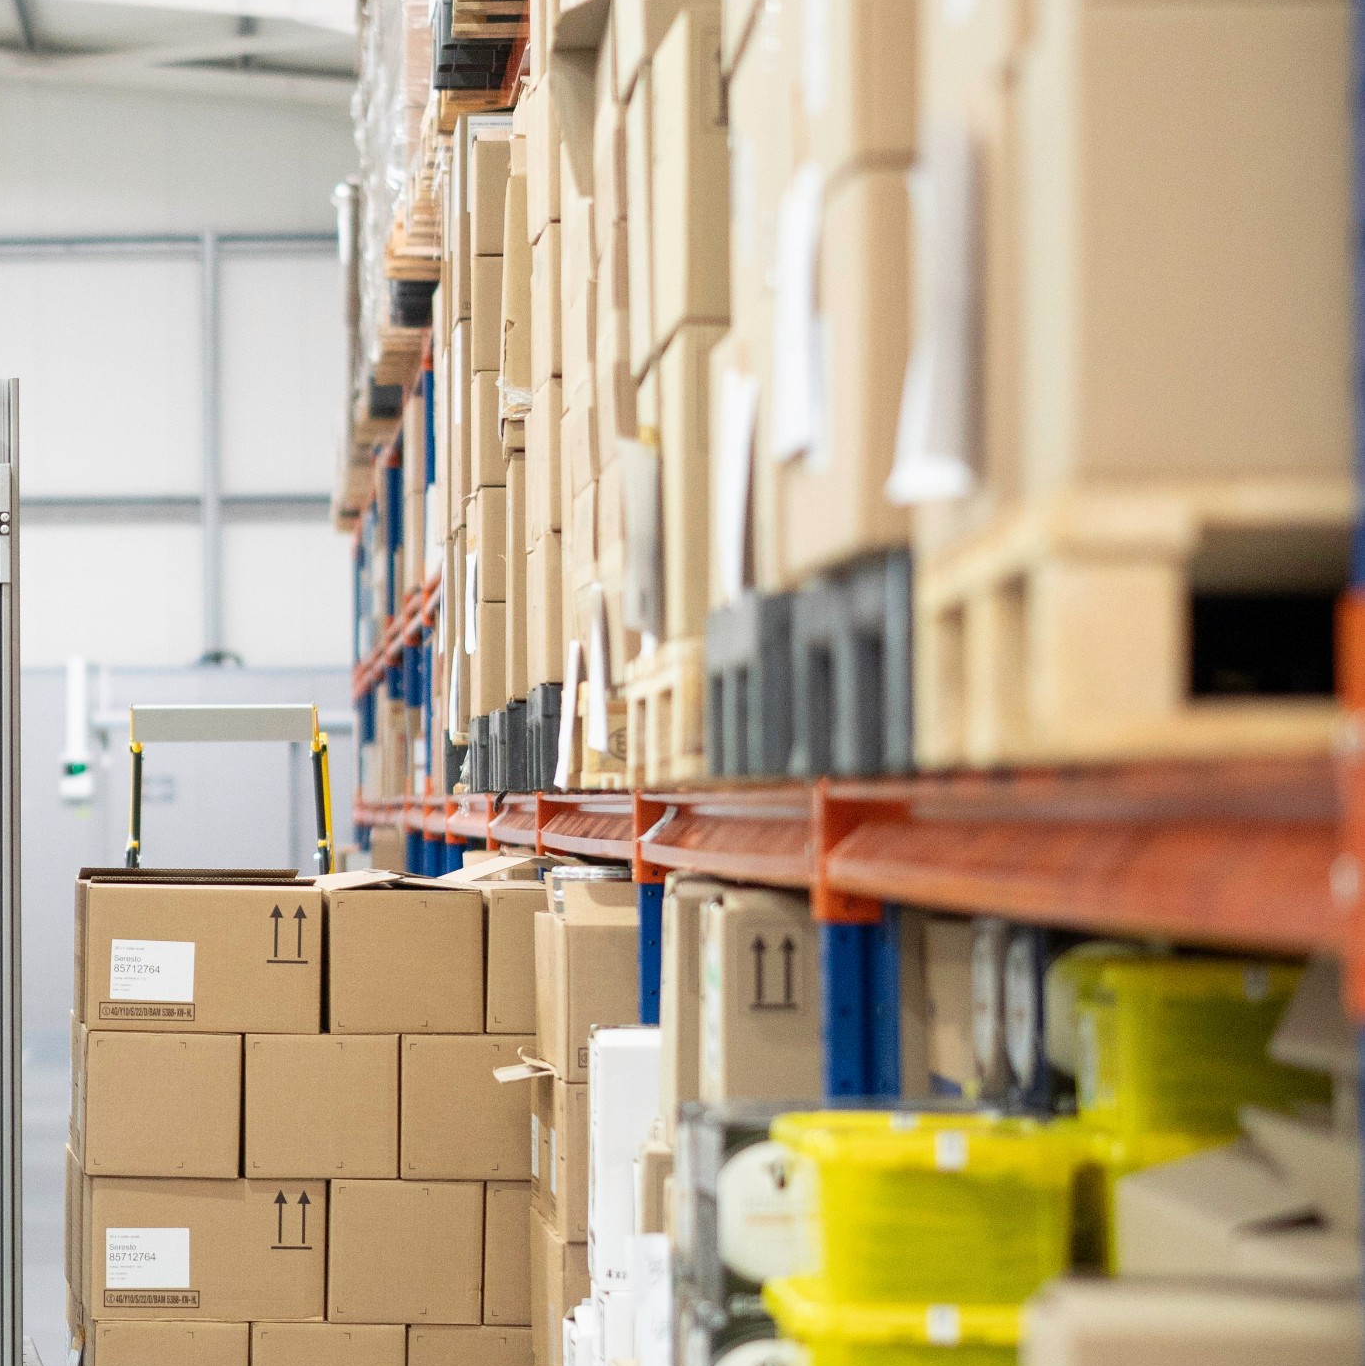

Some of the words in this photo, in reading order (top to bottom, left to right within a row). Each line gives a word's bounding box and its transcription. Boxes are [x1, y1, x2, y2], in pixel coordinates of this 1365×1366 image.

[114, 955, 141, 963] Seresto
[114, 964, 160, 974] 85712764
[109, 1243, 137, 1251] Seresto
[109, 1252, 156, 1262] 85712764
